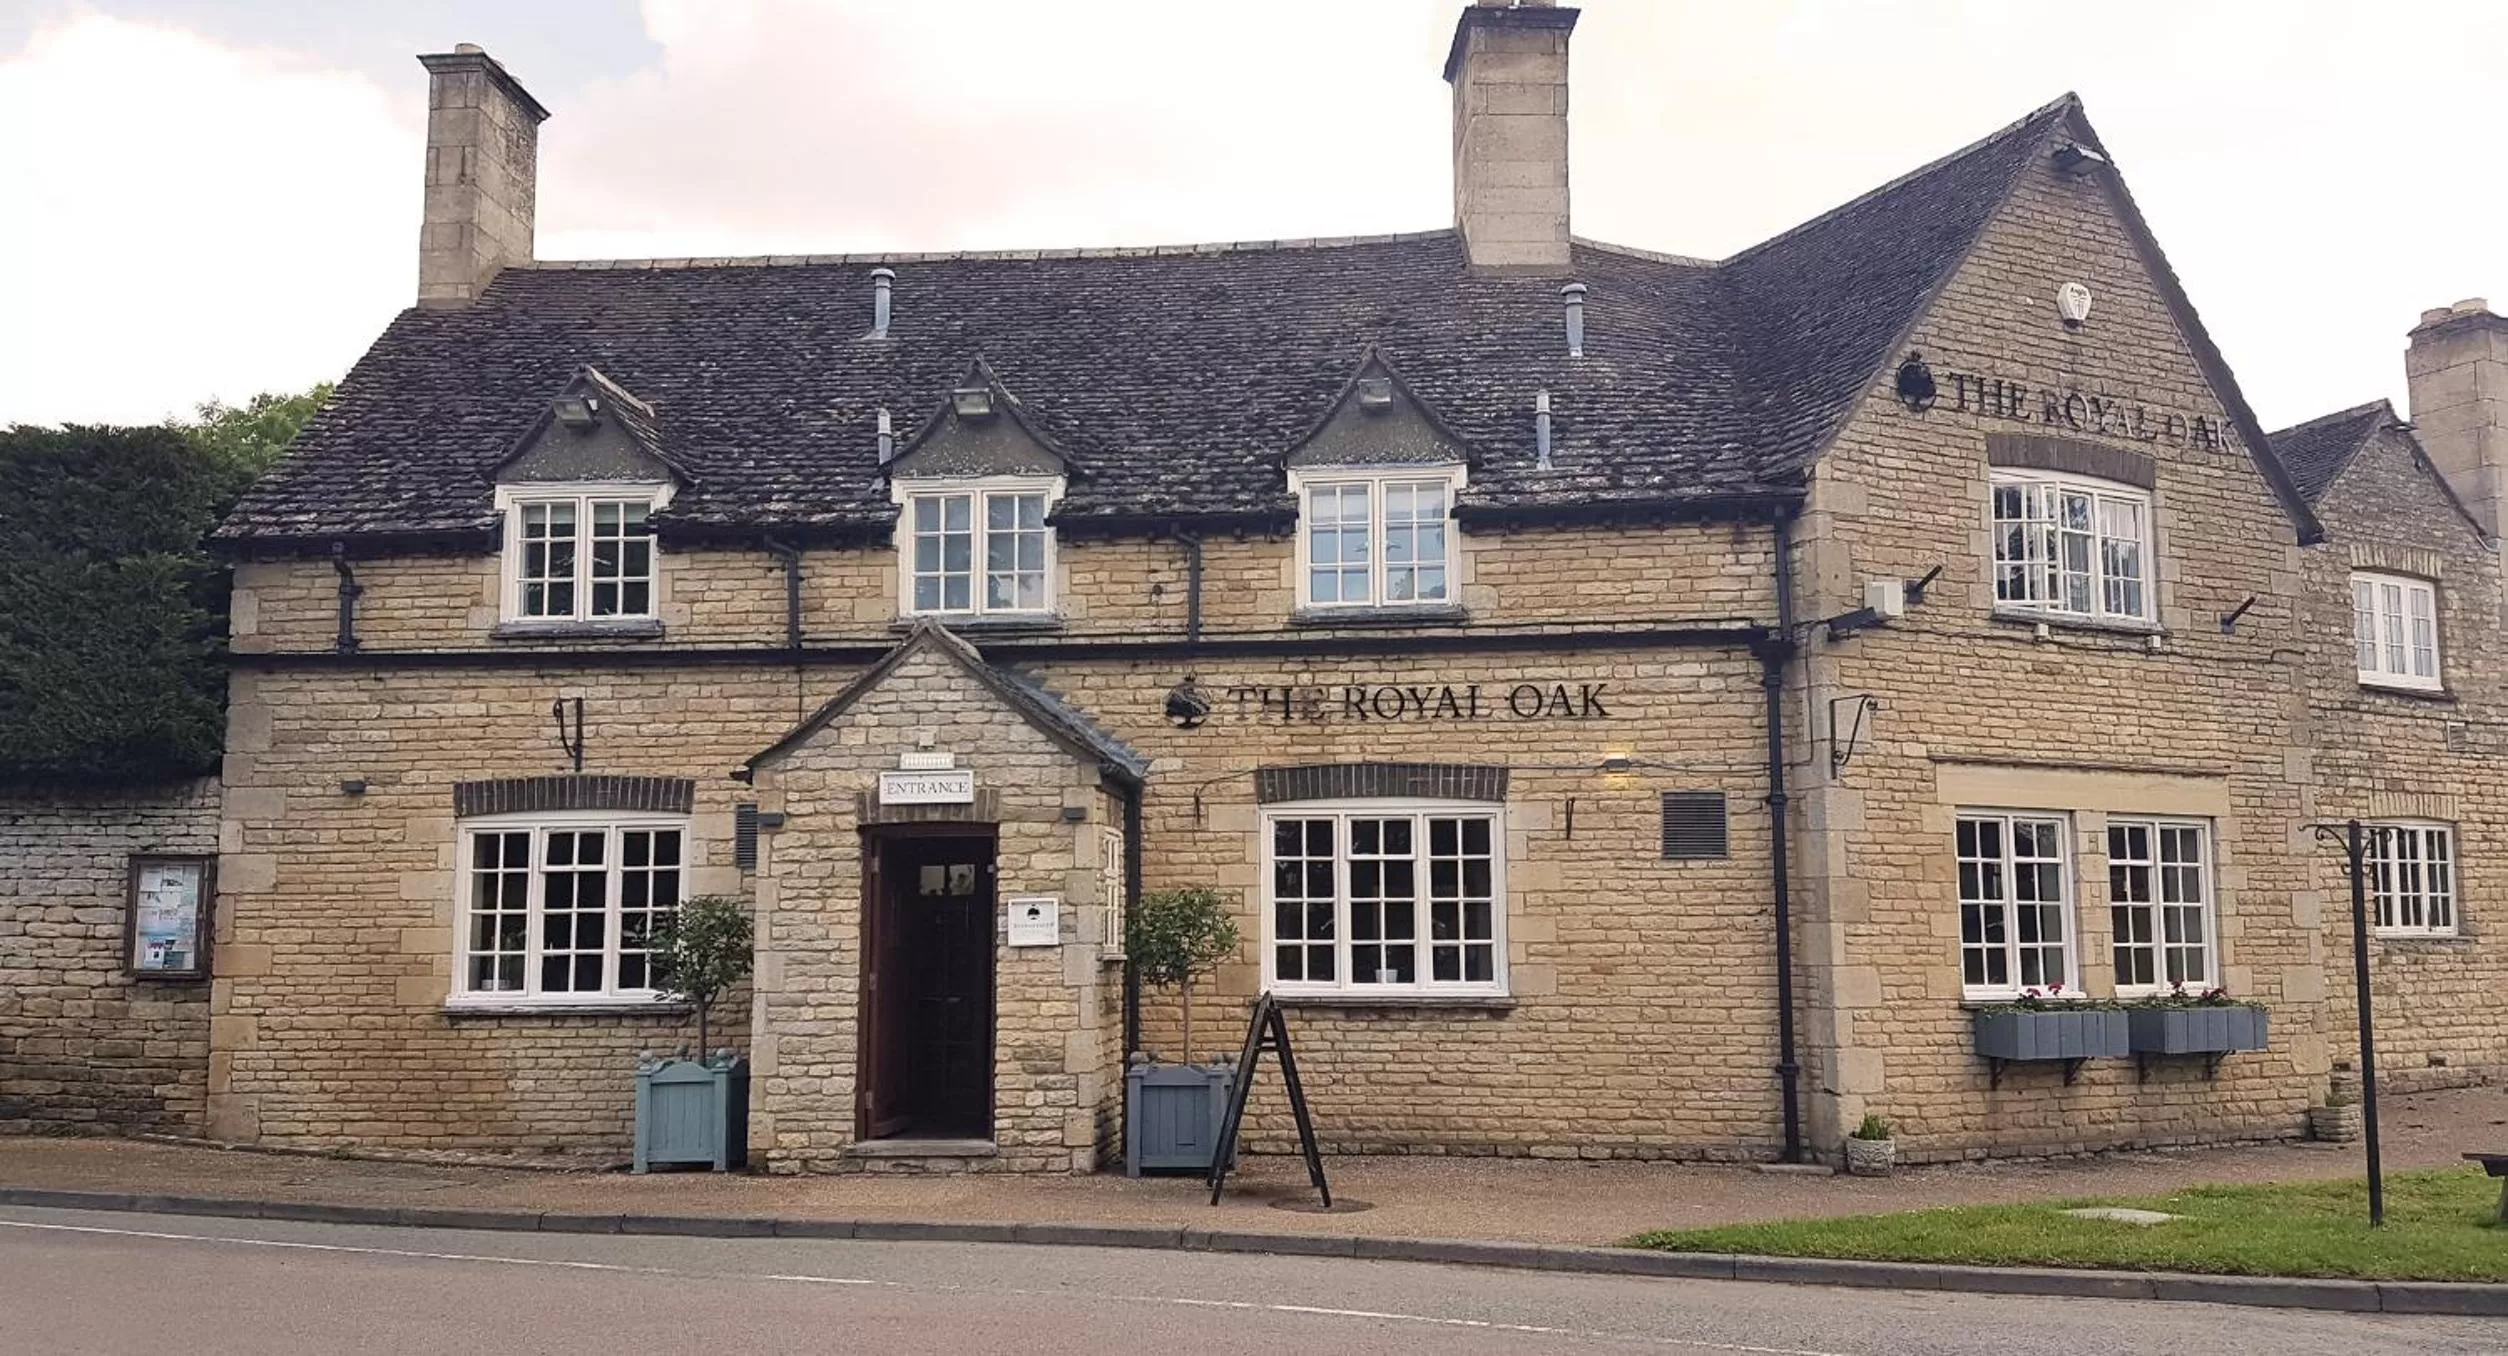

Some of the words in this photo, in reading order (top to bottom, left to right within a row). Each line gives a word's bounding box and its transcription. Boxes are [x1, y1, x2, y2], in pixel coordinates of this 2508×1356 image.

[1949, 373, 2030, 420] THE
[2044, 389, 2158, 441] ROYAL
[2167, 412, 2234, 452] OAK
[1227, 685, 1326, 720] THE
[1344, 685, 1492, 721] ROYAL
[1509, 683, 1613, 718] OAK
[886, 782, 970, 795] ENTRANCE
